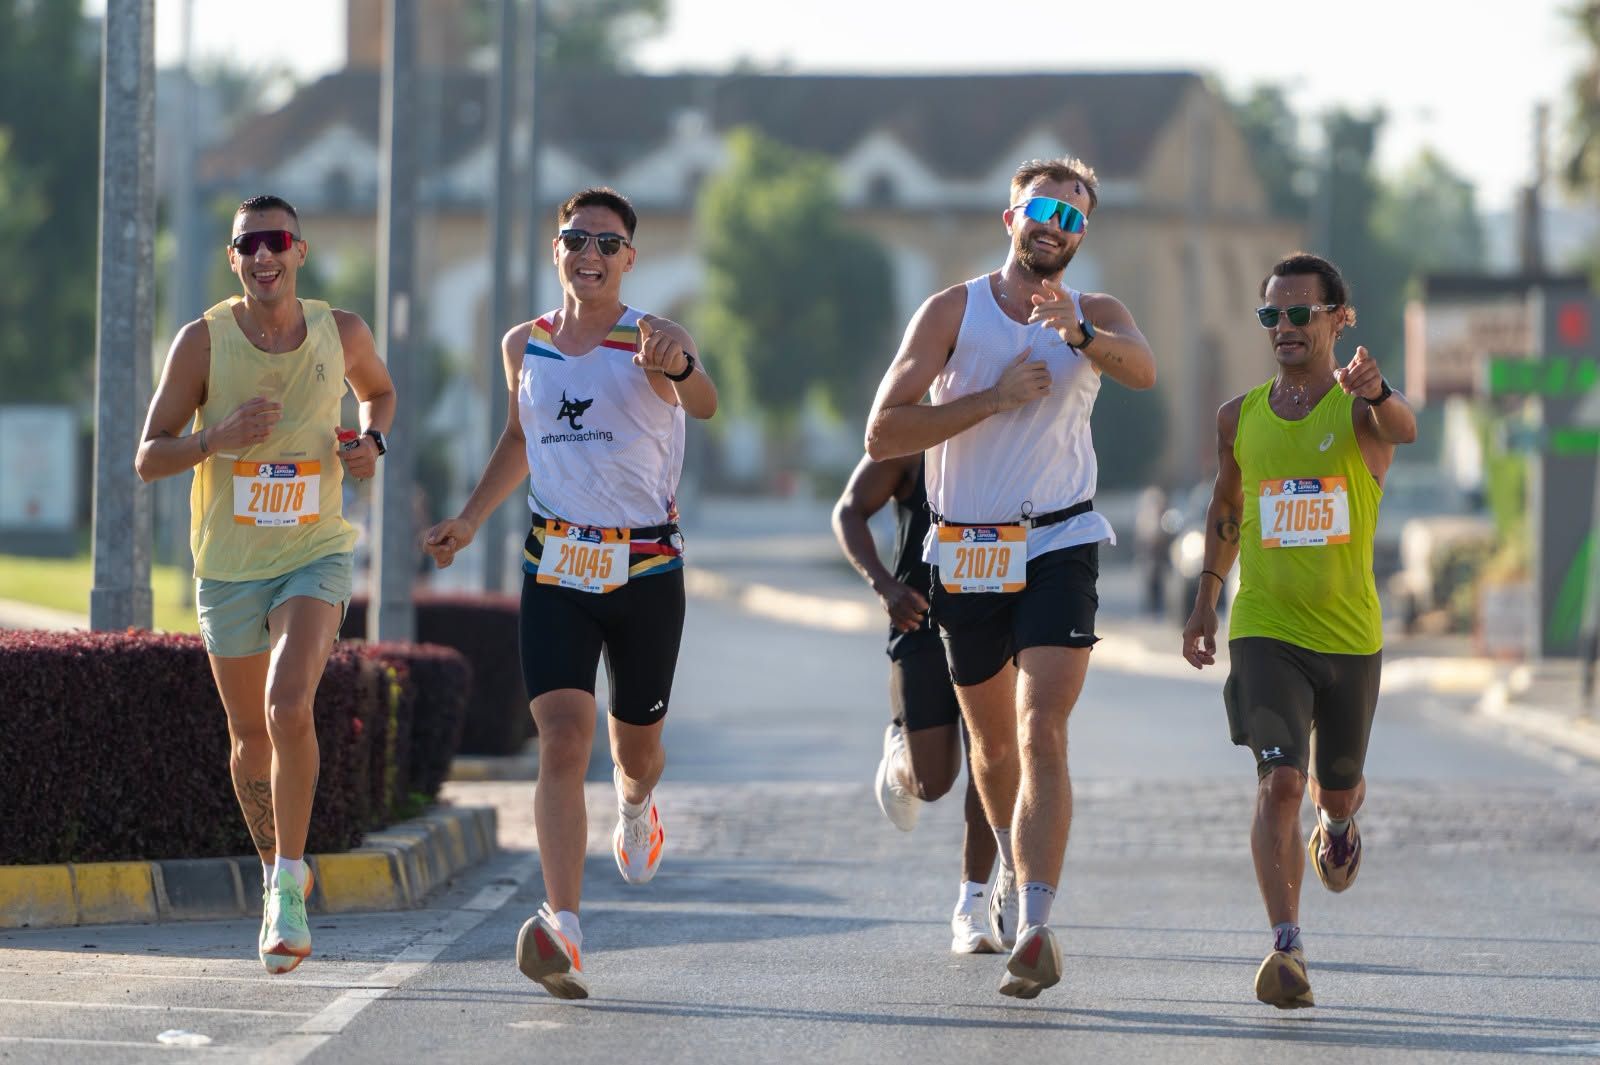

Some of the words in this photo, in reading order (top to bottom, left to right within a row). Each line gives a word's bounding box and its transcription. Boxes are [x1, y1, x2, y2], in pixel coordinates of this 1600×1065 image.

[248, 482, 305, 512] 21078
[1273, 499, 1334, 532] 21055
[554, 543, 615, 578] 21045
[953, 547, 1011, 578] 21079
